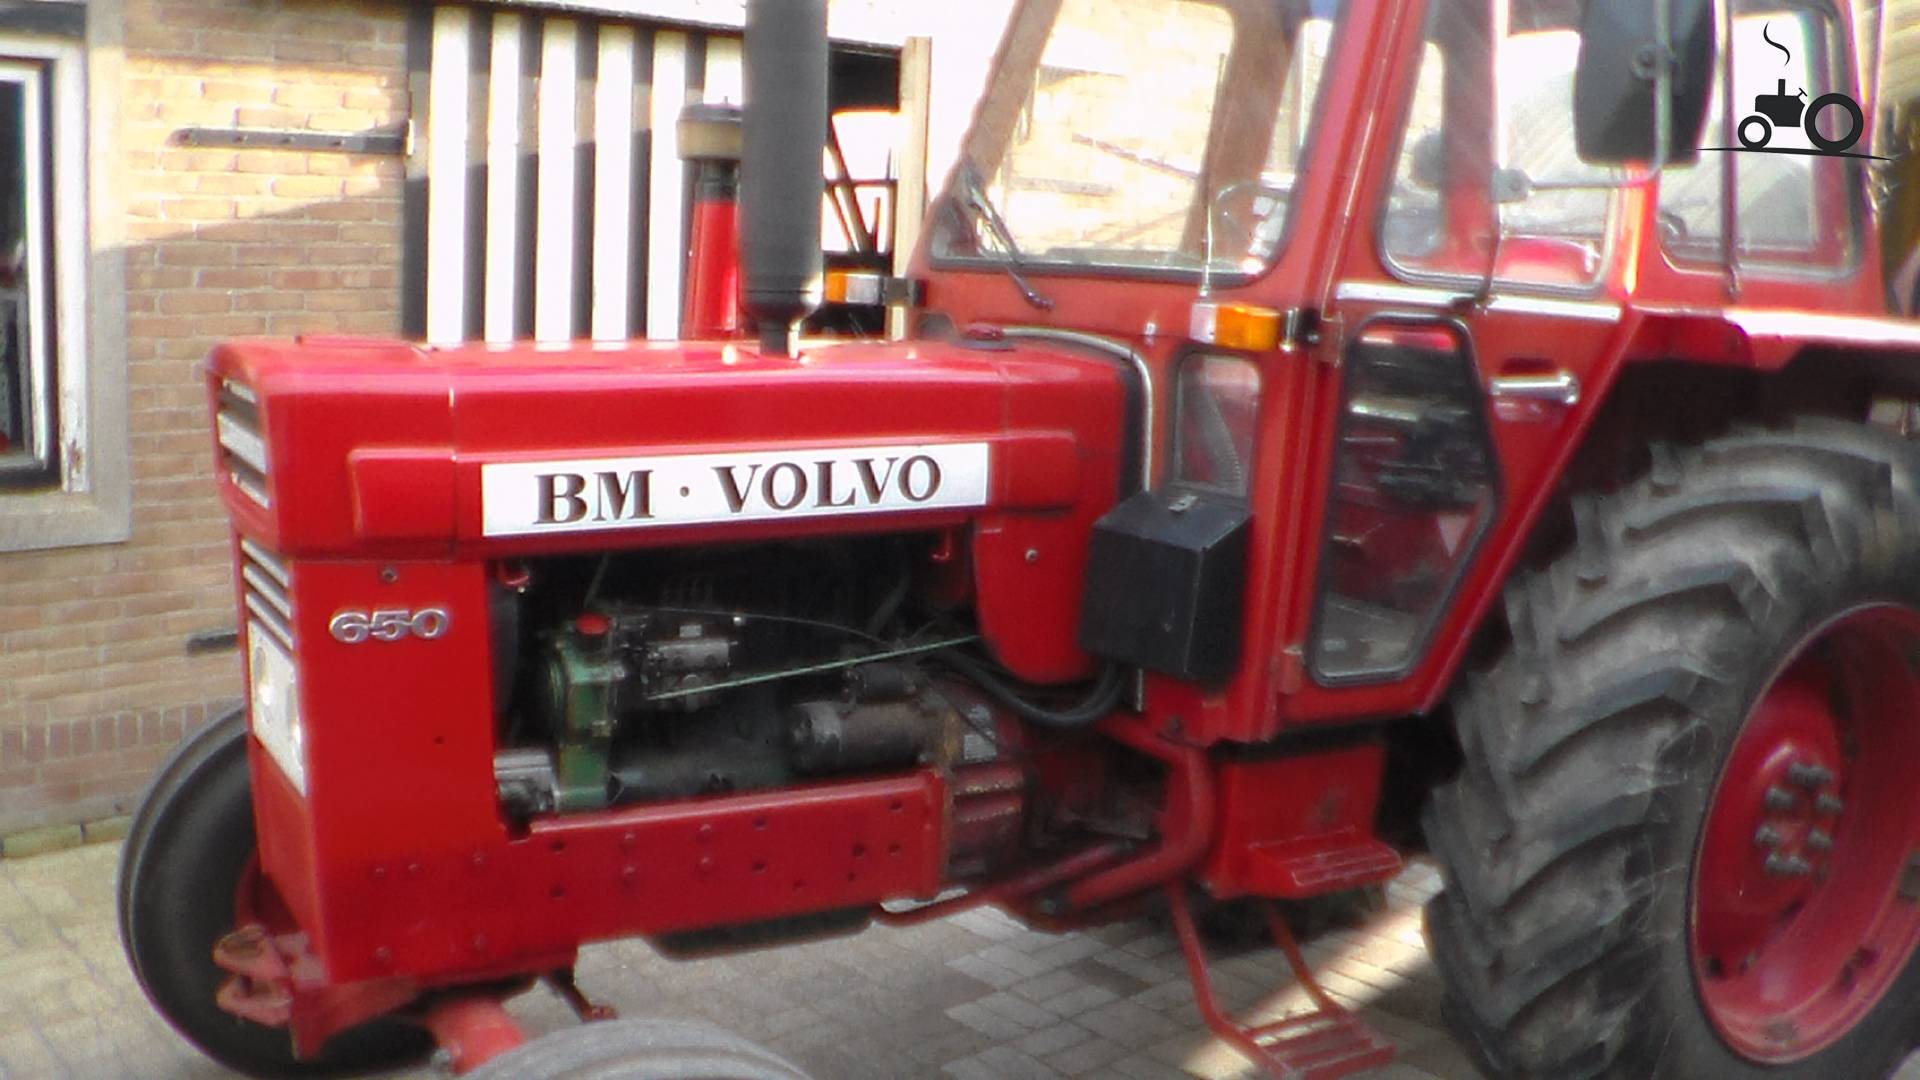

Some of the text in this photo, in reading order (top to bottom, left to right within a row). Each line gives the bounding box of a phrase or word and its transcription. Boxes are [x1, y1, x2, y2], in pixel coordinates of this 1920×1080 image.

[532, 469, 655, 525] BM
[711, 455, 942, 514] VOLVO
[329, 608, 449, 643] 650
